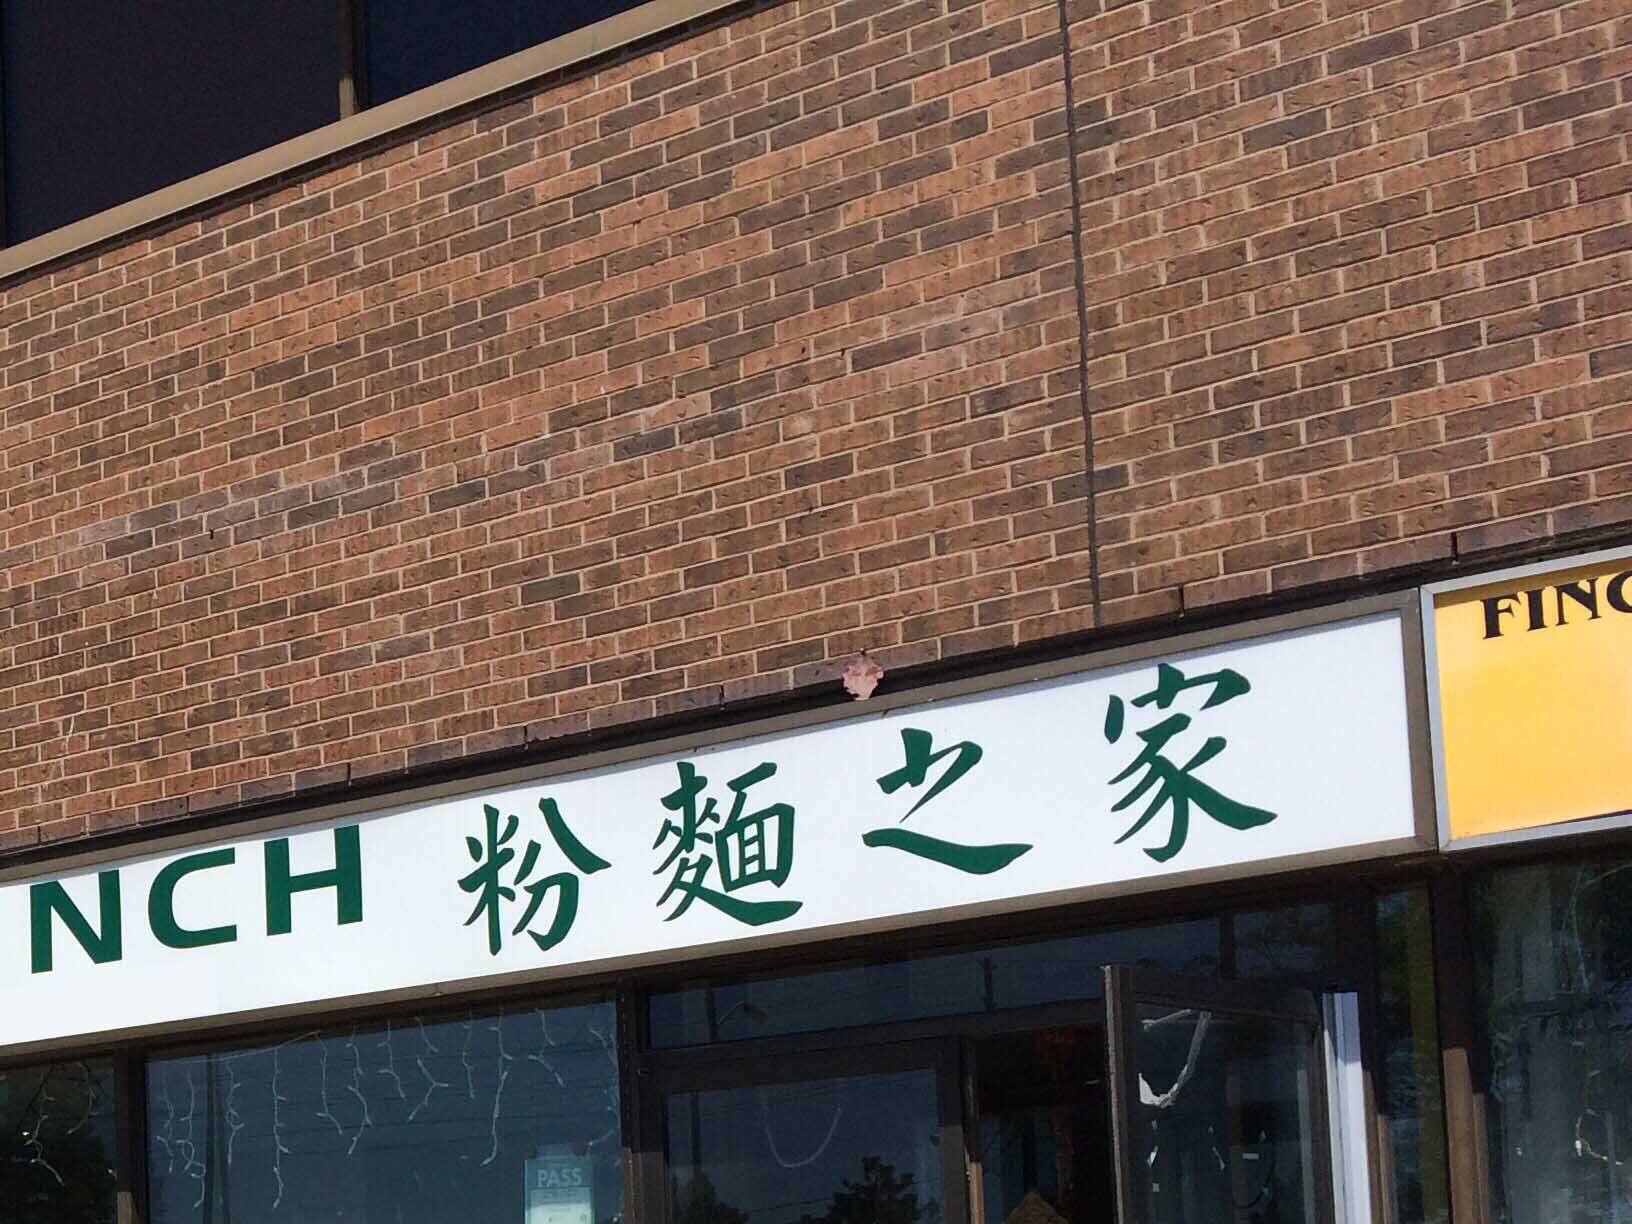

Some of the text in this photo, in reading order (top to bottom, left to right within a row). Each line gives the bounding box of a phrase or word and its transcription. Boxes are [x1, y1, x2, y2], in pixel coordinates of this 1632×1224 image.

[457, 662, 1279, 955] 粉麵之家
[536, 1167, 583, 1188] PASS
